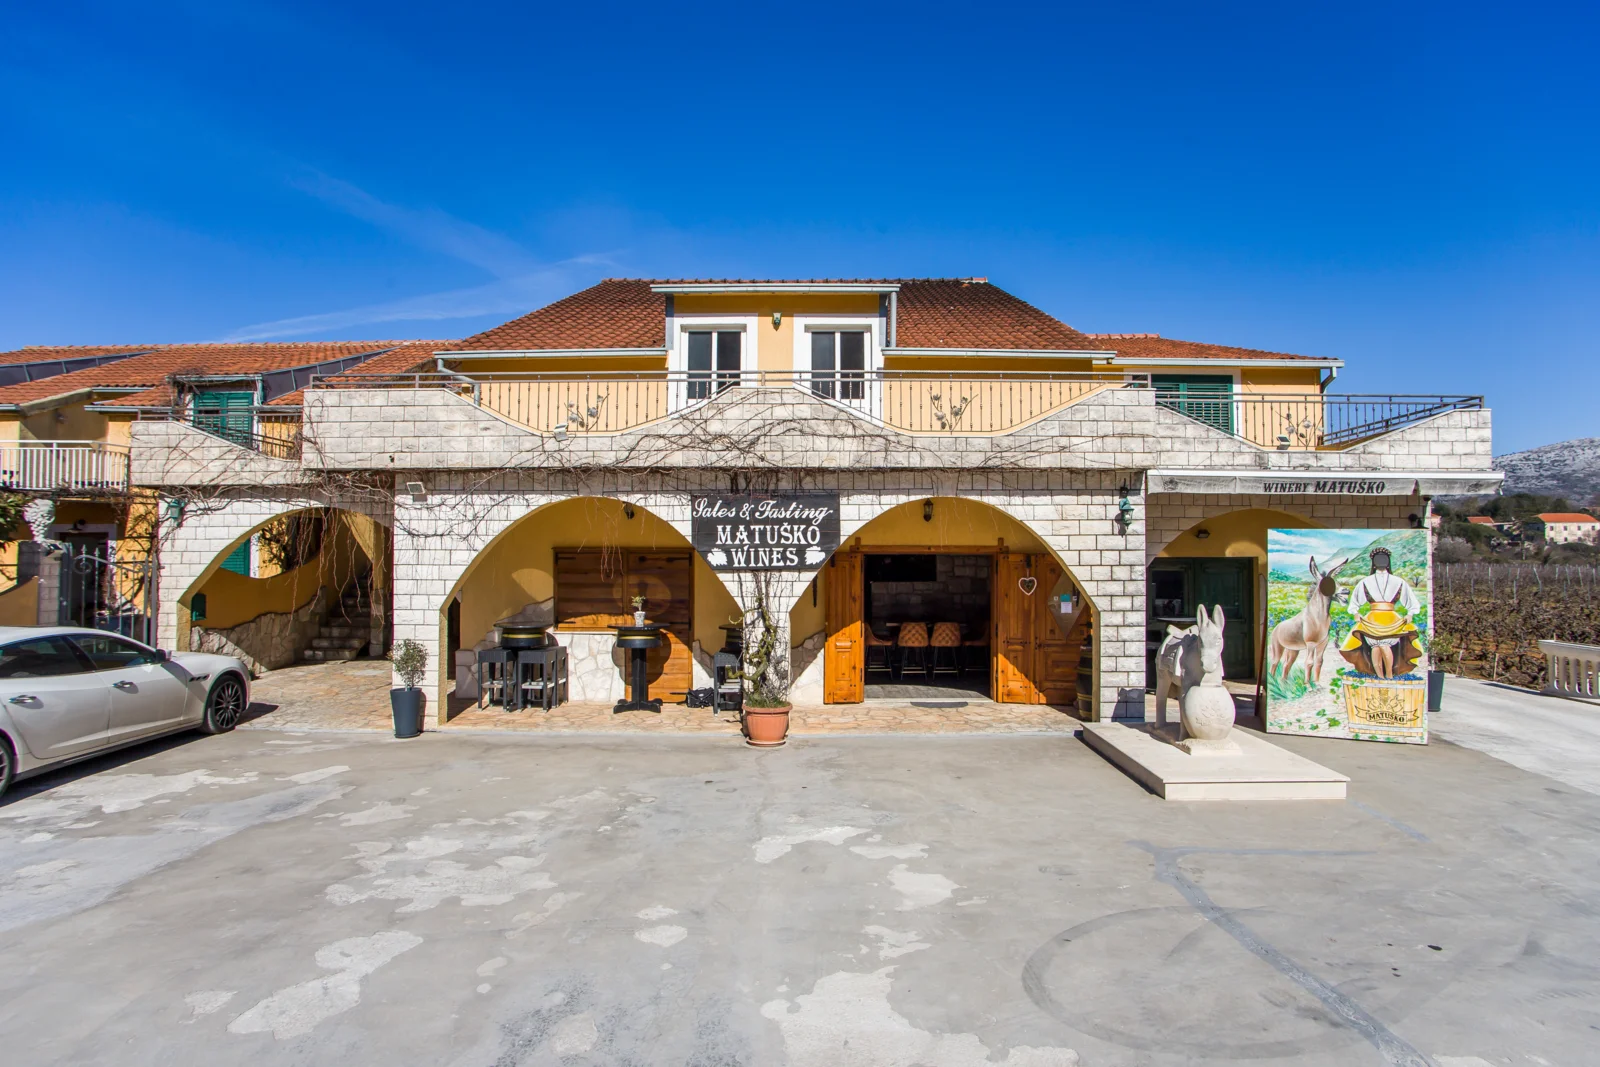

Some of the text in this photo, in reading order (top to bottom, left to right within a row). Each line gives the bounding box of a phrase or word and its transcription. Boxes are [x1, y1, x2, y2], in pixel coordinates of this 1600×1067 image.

[1263, 479, 1386, 494] WINERY MATUŠKO
[692, 497, 834, 526] Sales & Tasting
[715, 522, 821, 545] MATUŠKO
[730, 545, 799, 567] WINES
